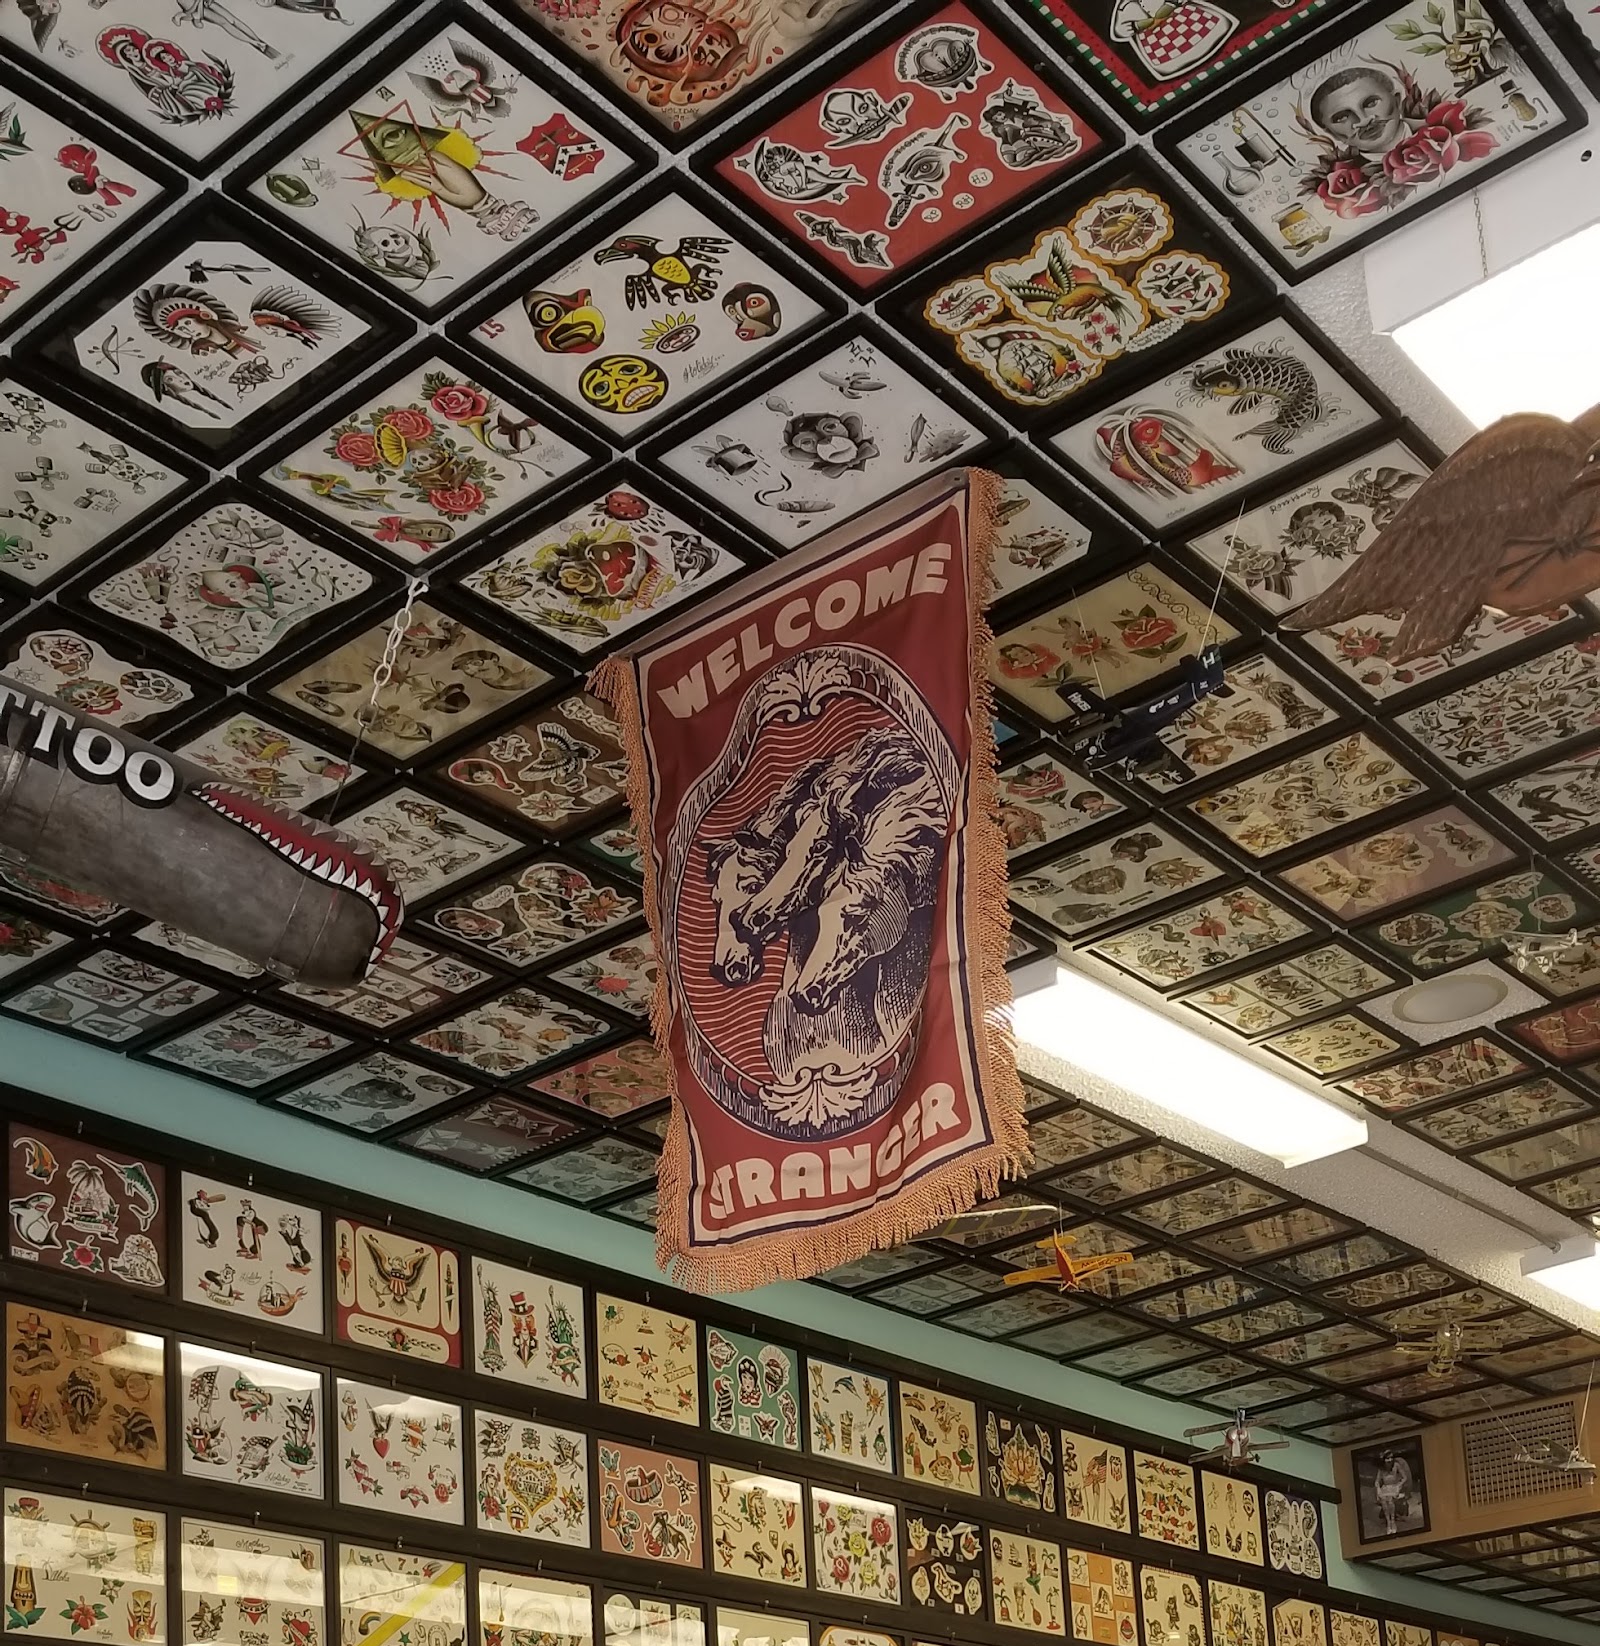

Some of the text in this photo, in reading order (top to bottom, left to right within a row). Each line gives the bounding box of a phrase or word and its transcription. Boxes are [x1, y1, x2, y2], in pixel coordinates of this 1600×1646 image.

[884, 131, 928, 189] SLEEP TIGHT
[970, 170, 988, 186] HJ
[948, 295, 976, 318] MOTHER
[479, 318, 506, 339] 15
[683, 355, 714, 384] Holiday
[634, 569, 663, 610] CARNIVORE
[657, 541, 951, 718] WELCOME
[709, 1082, 963, 1220] STRANGER
[235, 1538, 271, 1553] Mother
[397, 1556, 406, 1571] 7
